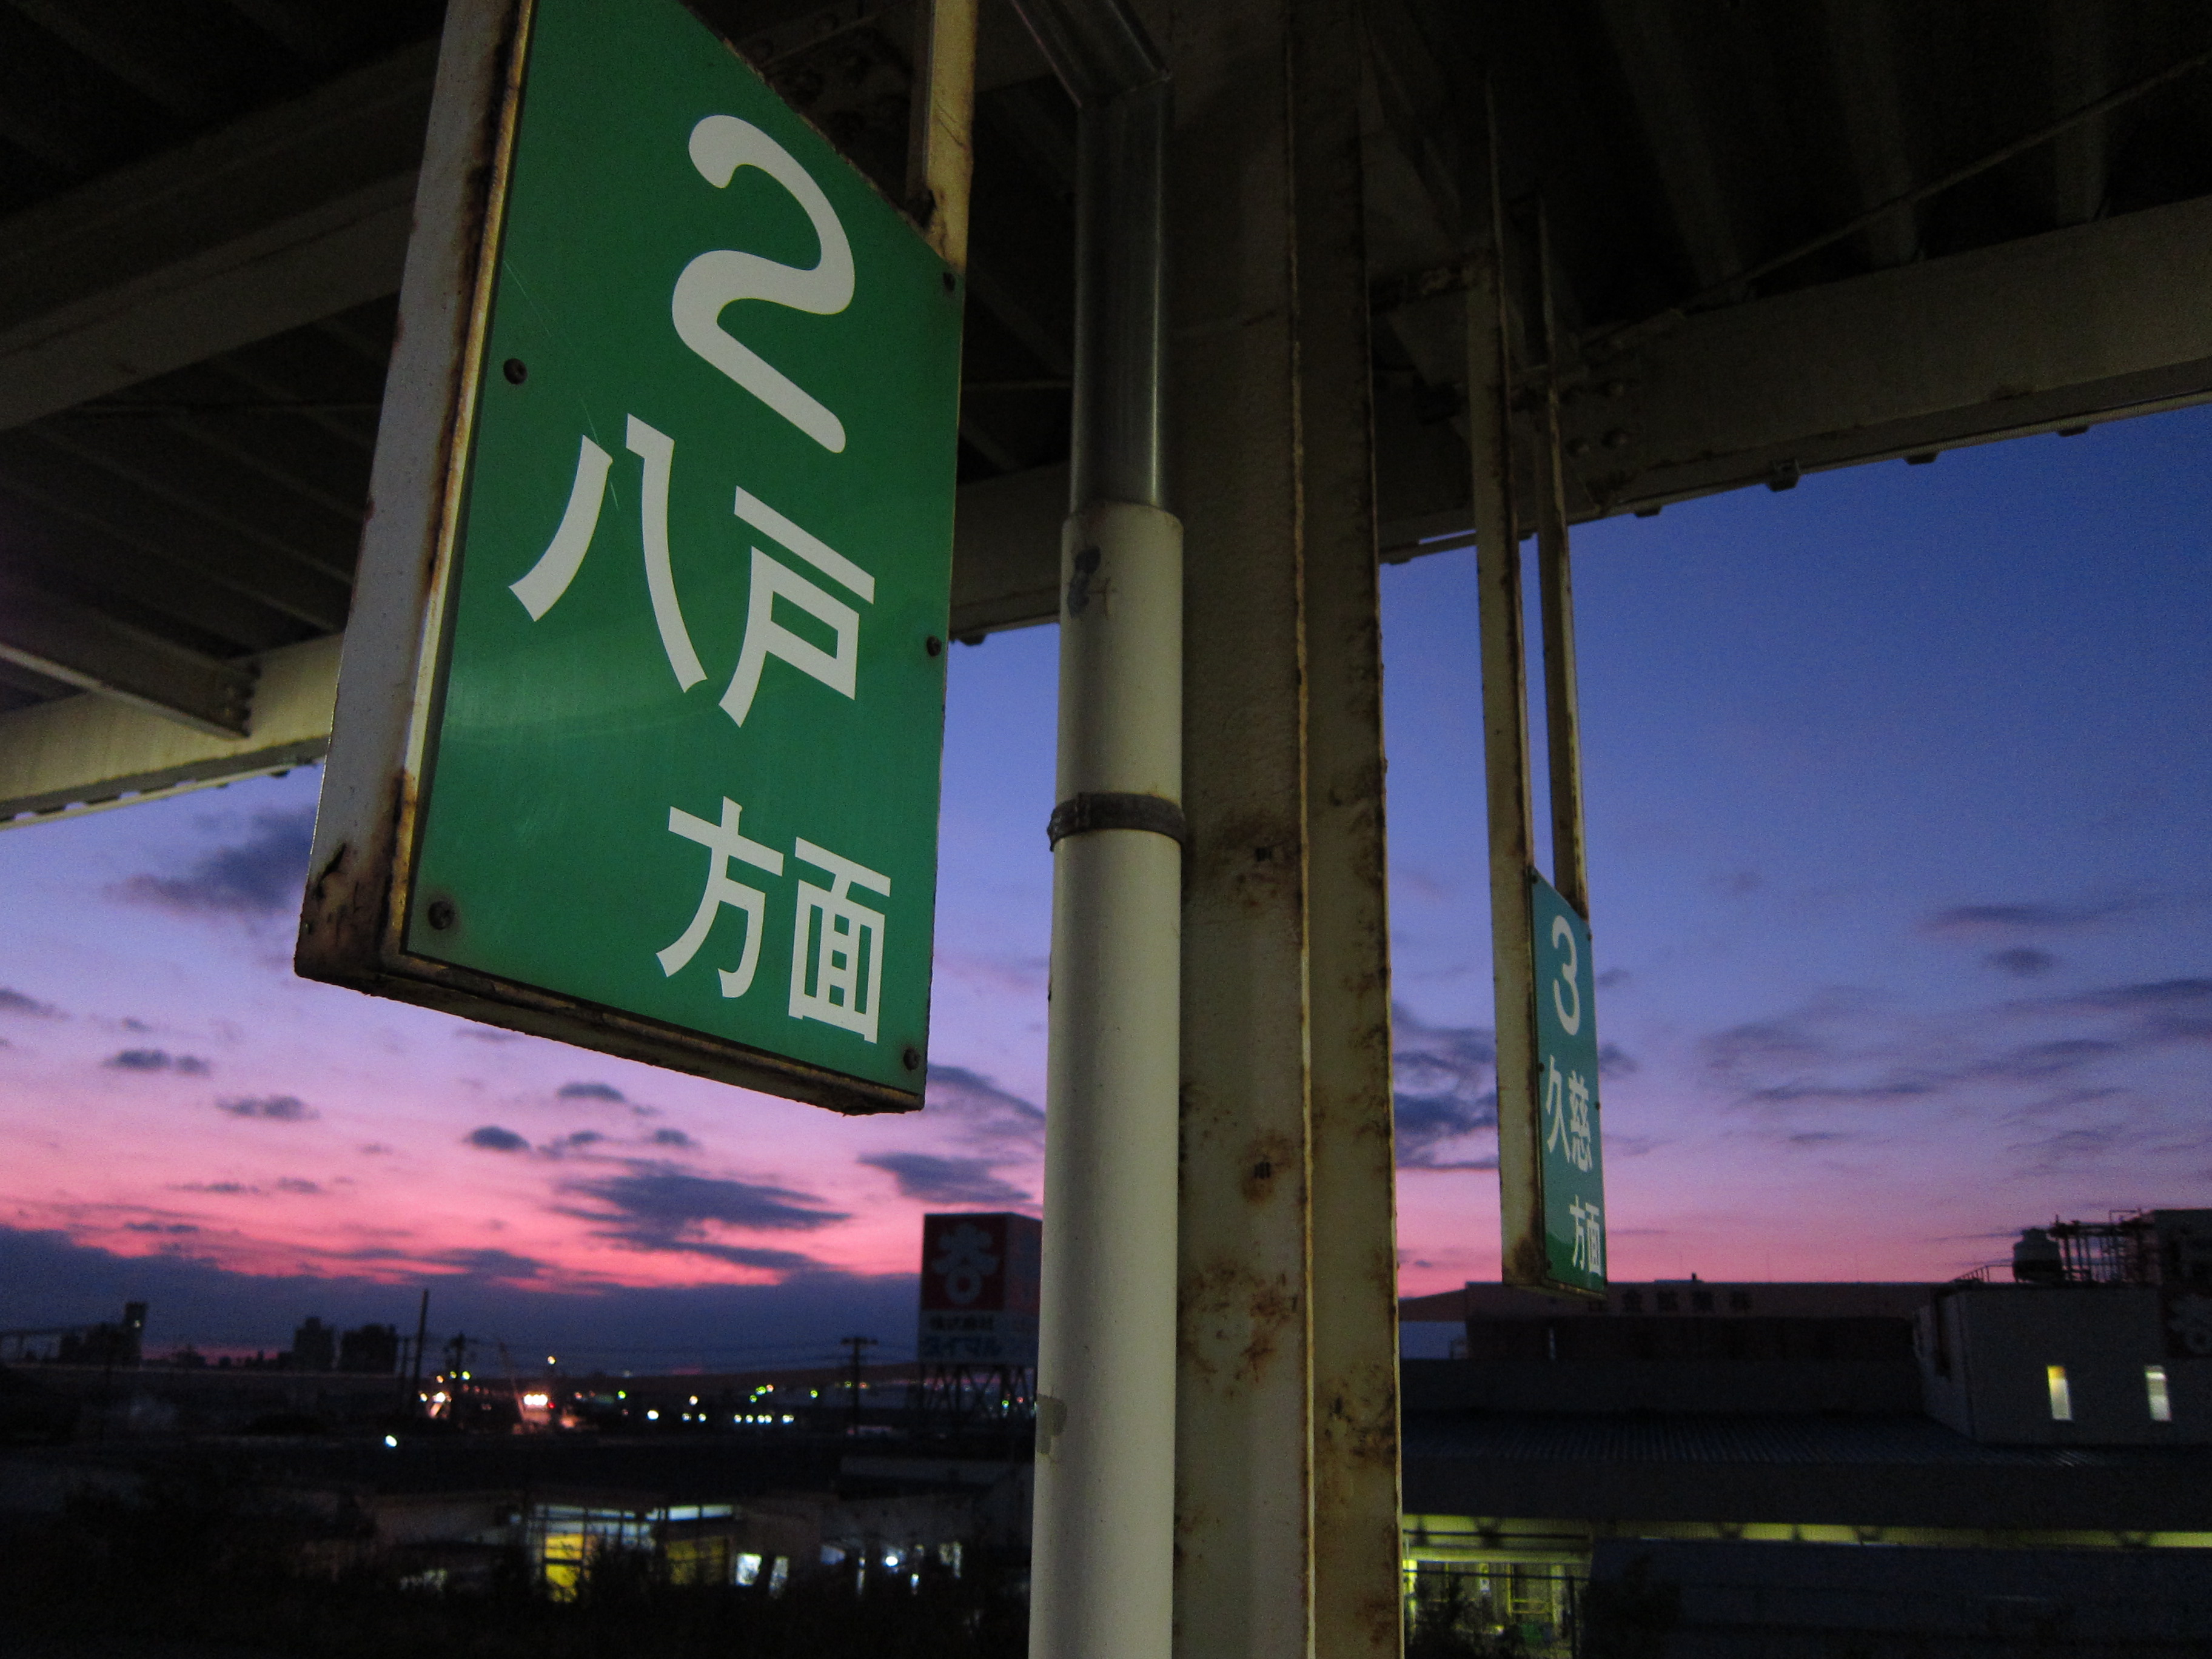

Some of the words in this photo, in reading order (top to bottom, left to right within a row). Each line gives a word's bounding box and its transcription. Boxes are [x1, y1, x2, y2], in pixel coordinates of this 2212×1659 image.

[672, 115, 855, 454] 2
[509, 412, 876, 726] 八戸
[657, 796, 891, 1044] 方面
[1552, 915, 1580, 1036] 3
[1546, 1054, 1593, 1173] 久慈
[1570, 1195, 1602, 1276] 方面
